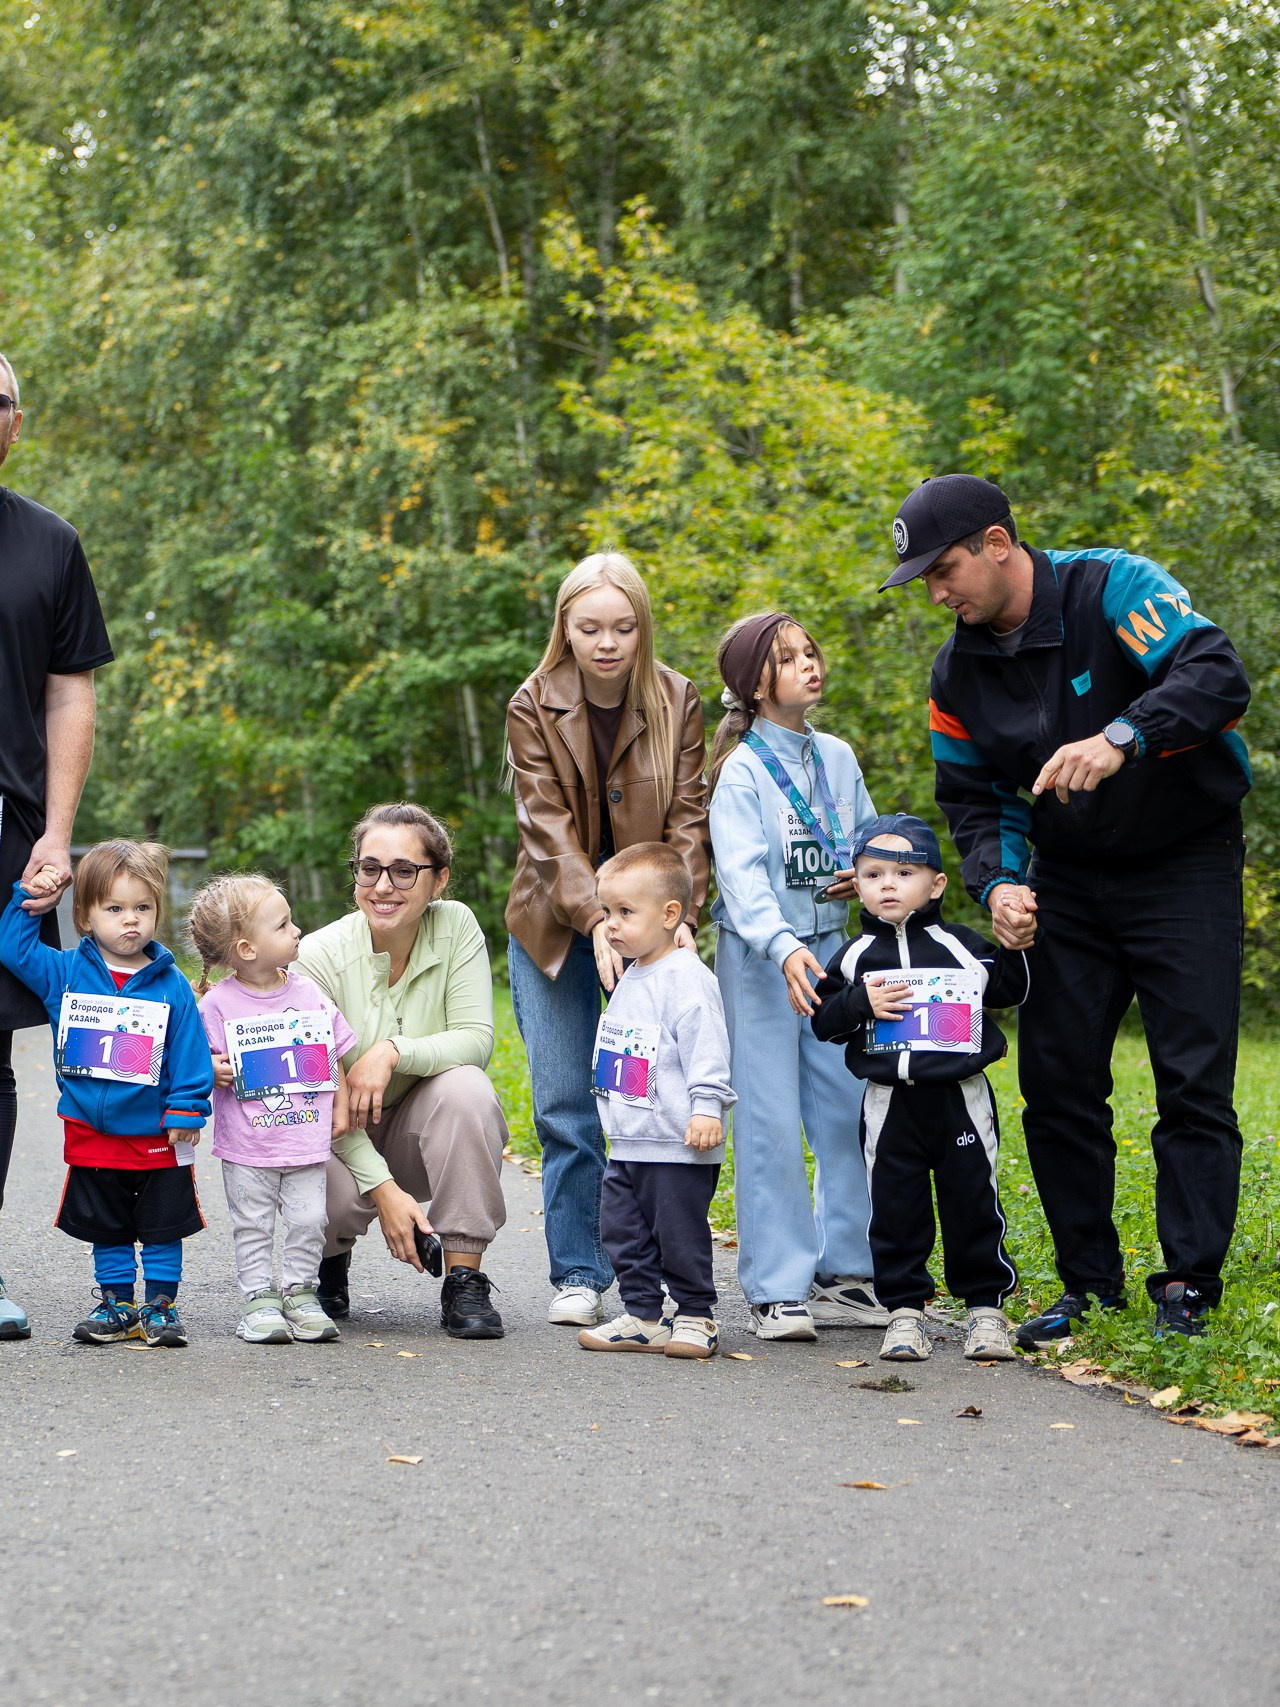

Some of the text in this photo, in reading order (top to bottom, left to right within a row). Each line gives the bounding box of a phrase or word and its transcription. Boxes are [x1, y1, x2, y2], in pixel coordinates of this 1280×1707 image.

[789, 828, 813, 836] КАЗАН
[793, 846, 838, 873] 100
[68, 1014, 101, 1024] КАЗАНЬ
[913, 1007, 929, 1036] 1
[99, 1035, 114, 1064] 1
[237, 1035, 275, 1047] КАЗАНЬ
[280, 1050, 298, 1078] 1
[613, 1058, 623, 1087] 1
[252, 1109, 320, 1128] MY MELODY
[956, 1131, 975, 1146] alo
